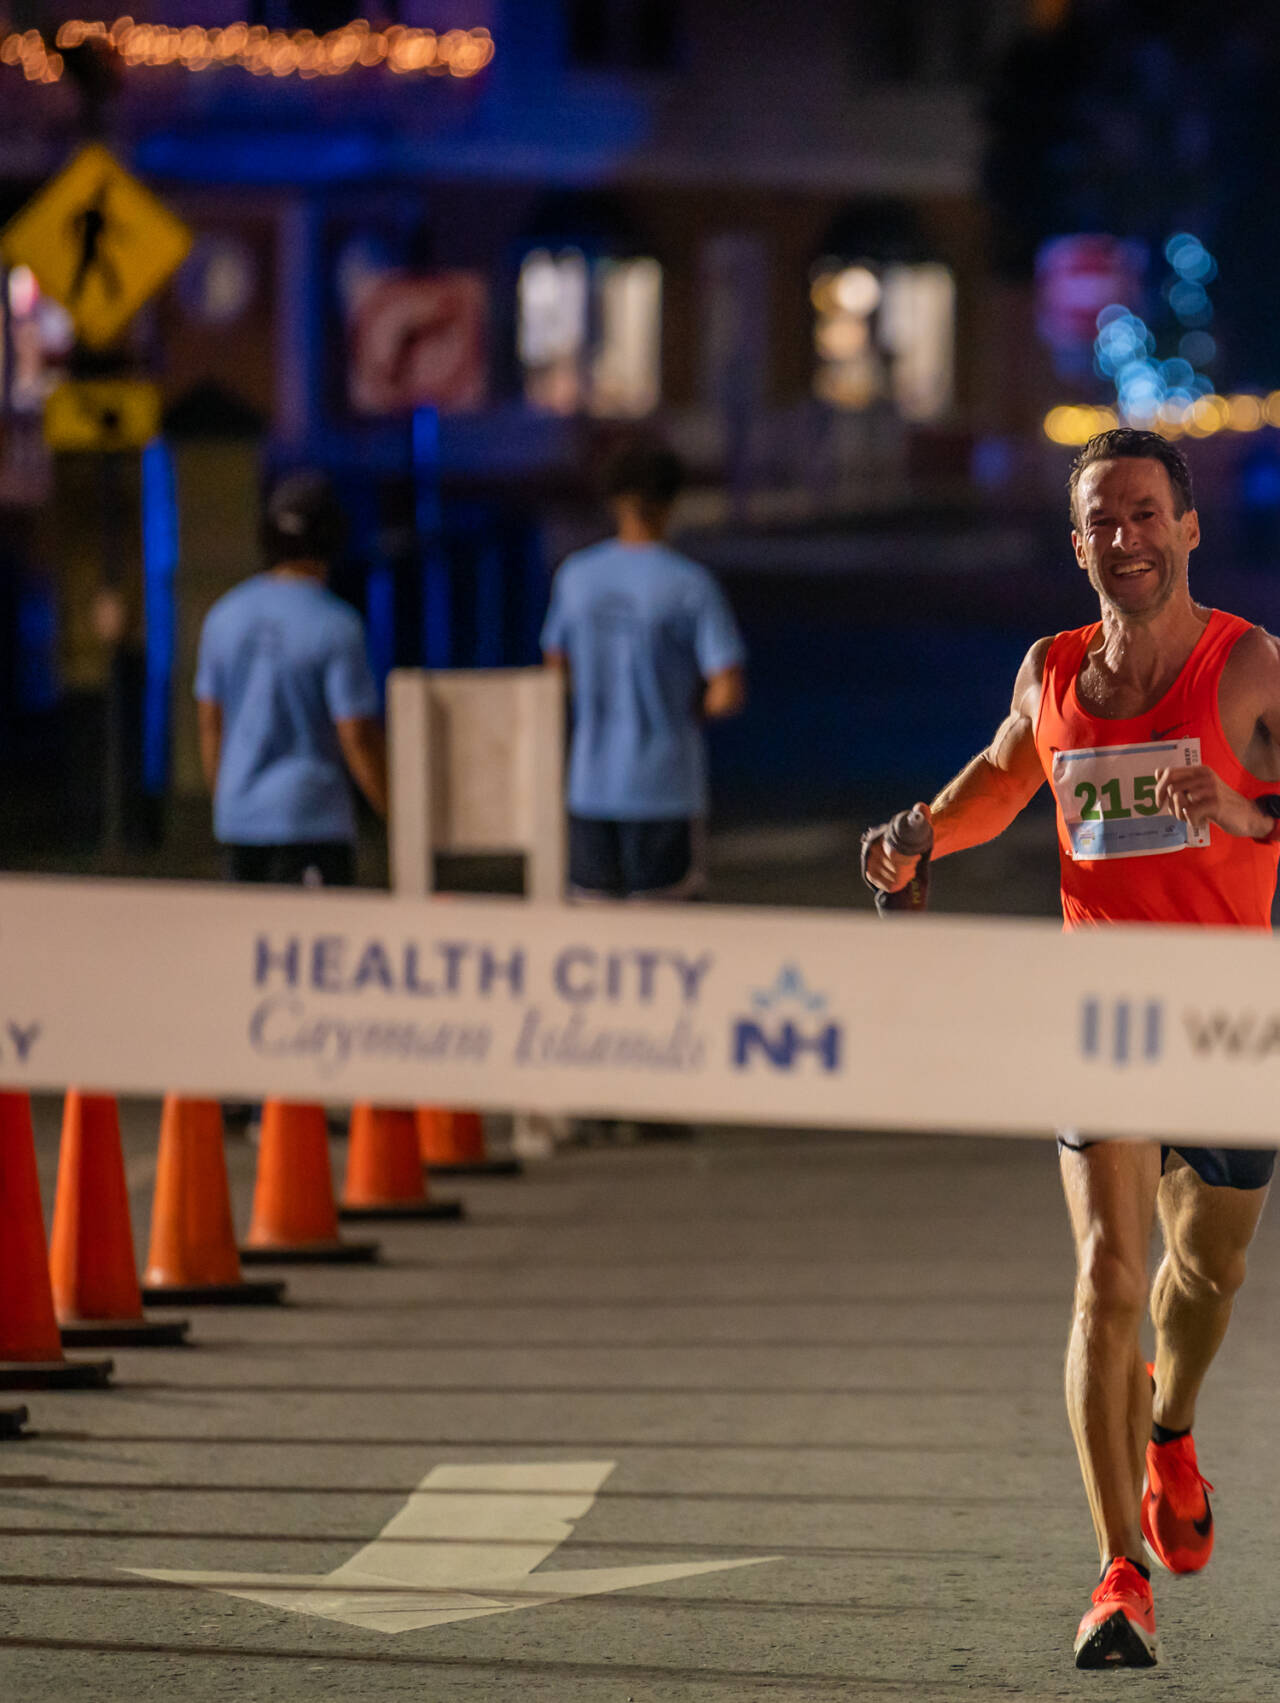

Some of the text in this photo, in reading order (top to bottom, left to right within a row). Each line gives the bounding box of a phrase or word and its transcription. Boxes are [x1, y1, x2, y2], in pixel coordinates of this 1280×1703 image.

[1074, 775, 1161, 821] 215
[253, 933, 716, 1006] HEALTH CITY
[248, 997, 712, 1079] Cayman Islands
